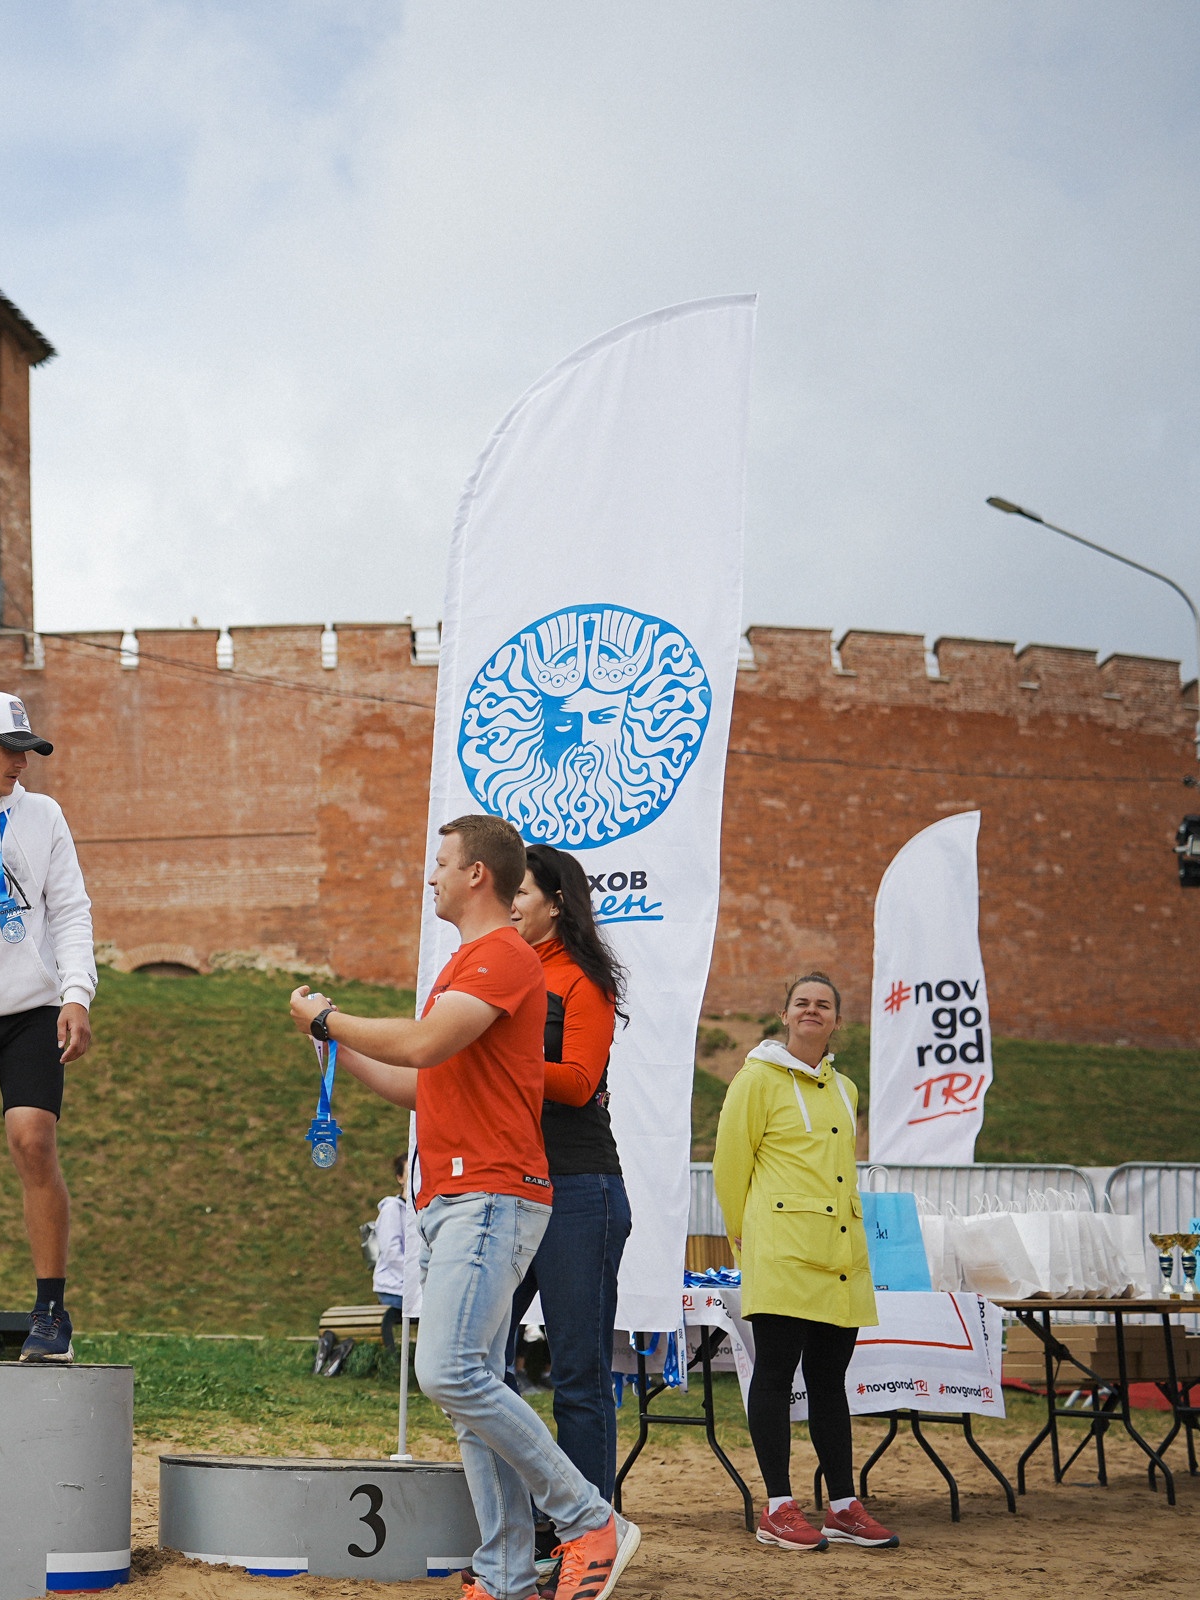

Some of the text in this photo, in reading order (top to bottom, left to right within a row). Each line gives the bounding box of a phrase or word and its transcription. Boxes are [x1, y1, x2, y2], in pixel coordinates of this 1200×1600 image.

[884, 978, 980, 1016] #nov
[931, 1006, 982, 1040] go
[916, 1028, 985, 1068] rod
[913, 1072, 985, 1108] TRI
[347, 1483, 387, 1559] 3
